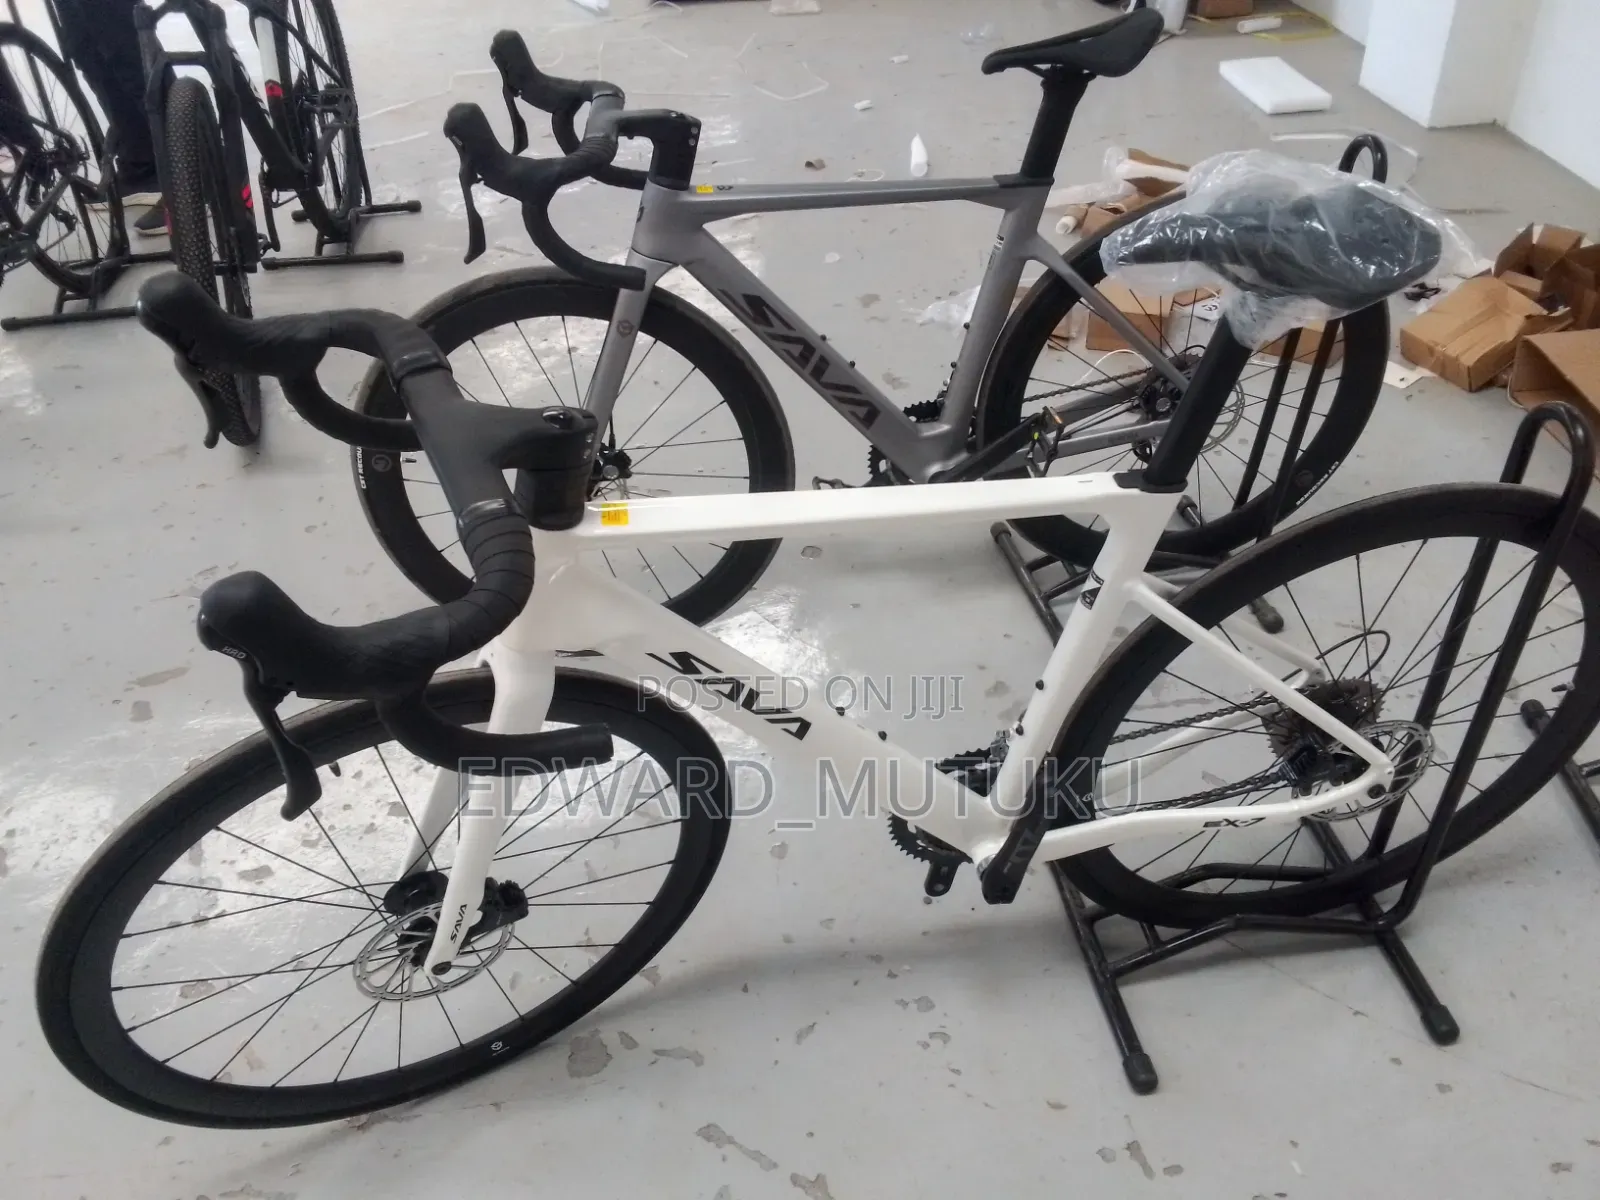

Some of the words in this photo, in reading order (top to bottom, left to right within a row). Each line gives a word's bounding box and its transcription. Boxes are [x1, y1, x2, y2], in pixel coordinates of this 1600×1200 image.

[717, 288, 881, 431] SAVA
[356, 446, 364, 474] RECOU
[645, 651, 812, 741] SAVA
[450, 904, 468, 944] SAVA
